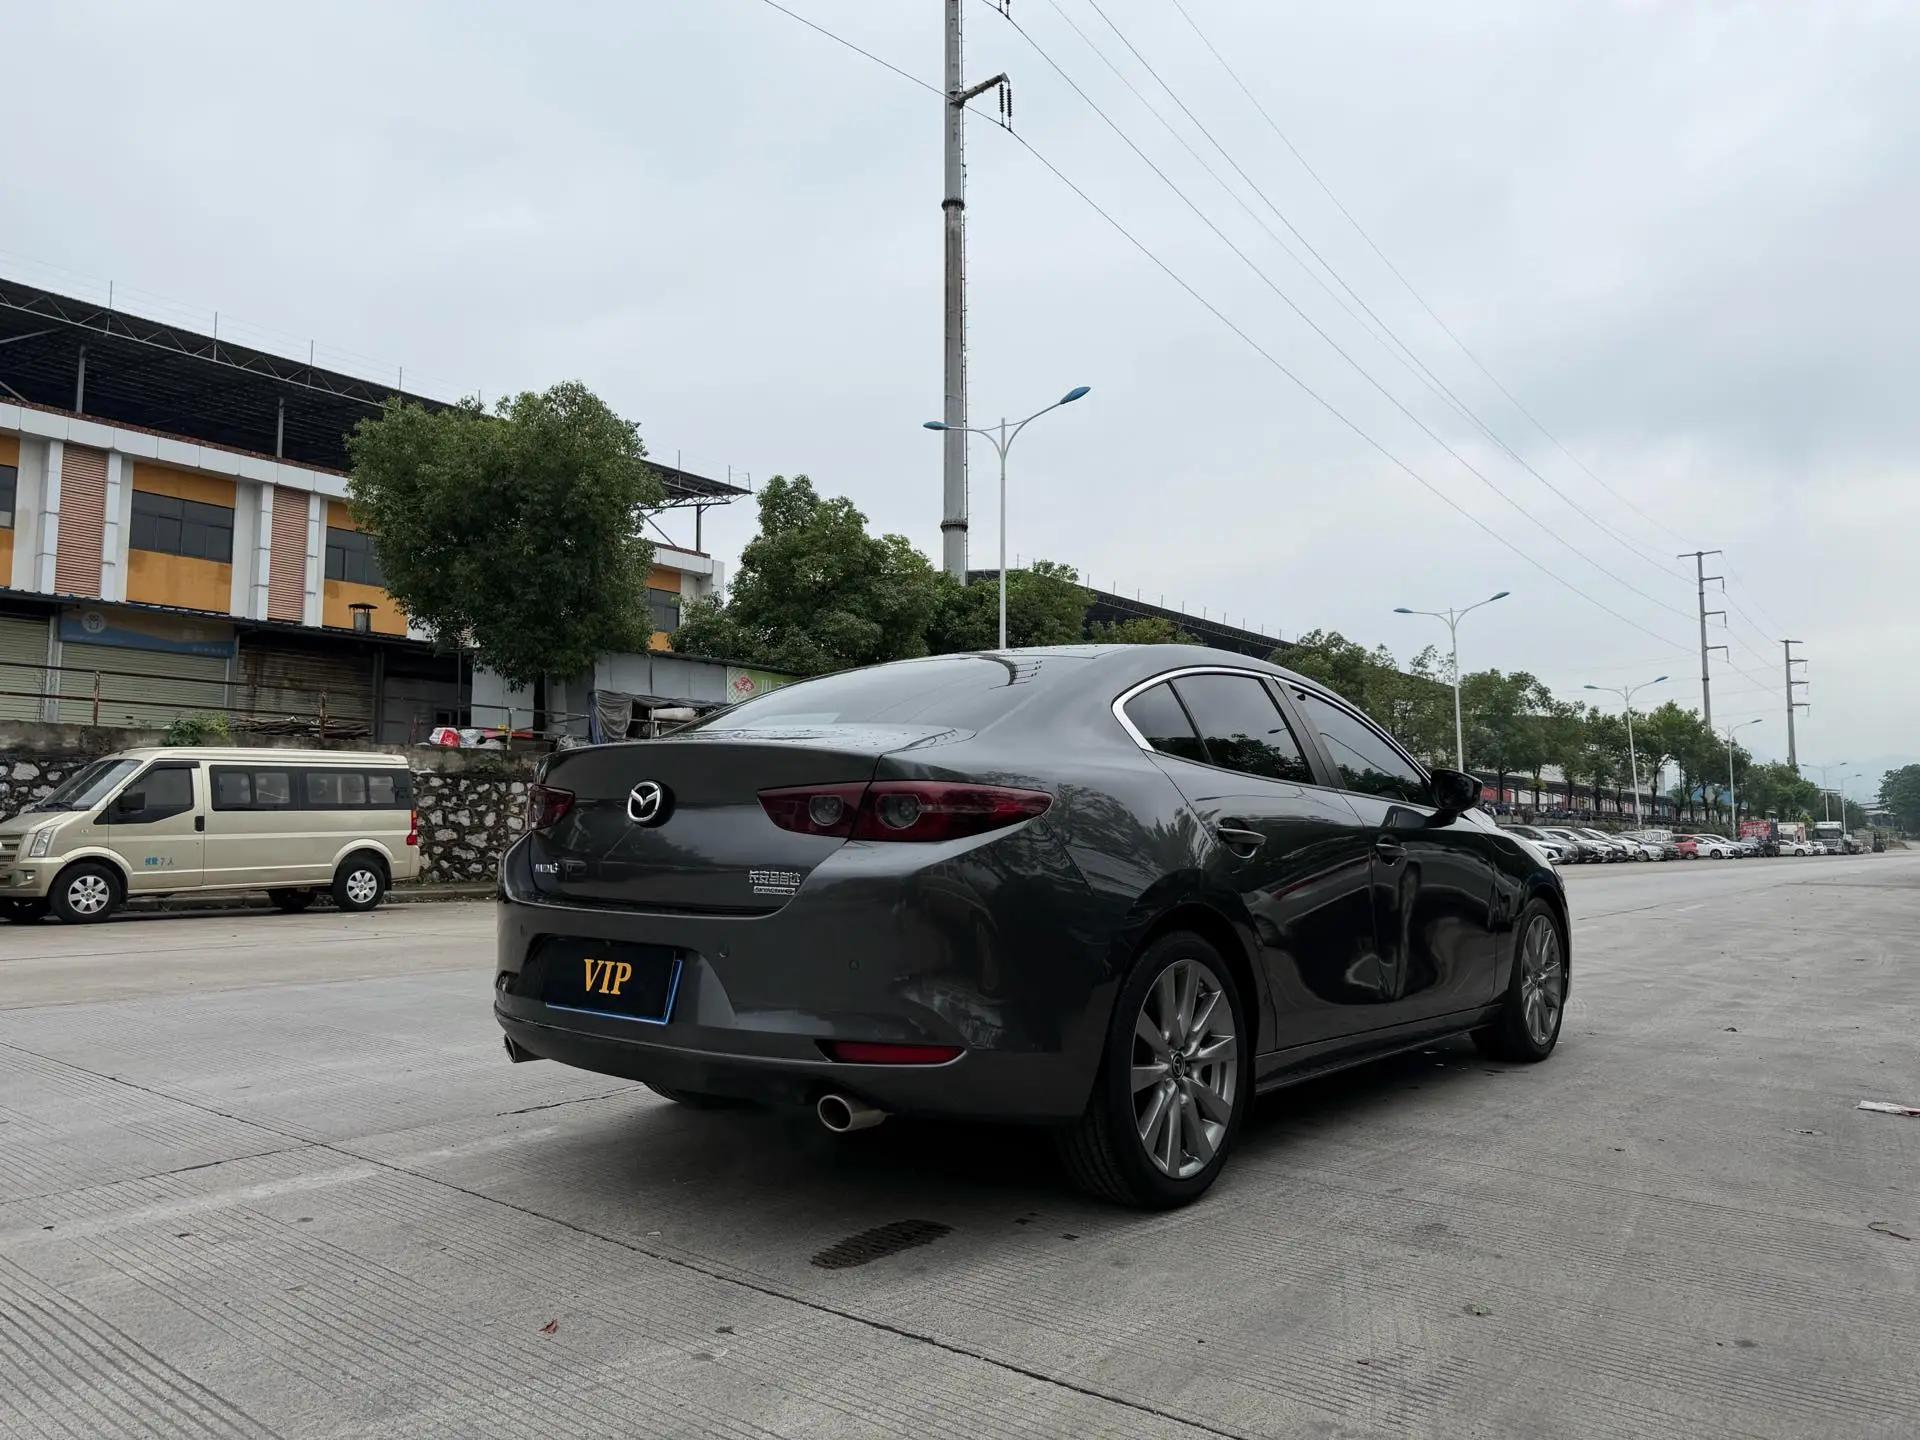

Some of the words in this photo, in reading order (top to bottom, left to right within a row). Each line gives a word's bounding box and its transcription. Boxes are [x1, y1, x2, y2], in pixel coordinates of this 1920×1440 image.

[748, 870, 801, 886] 长安马自达
[584, 958, 632, 995] VIP
